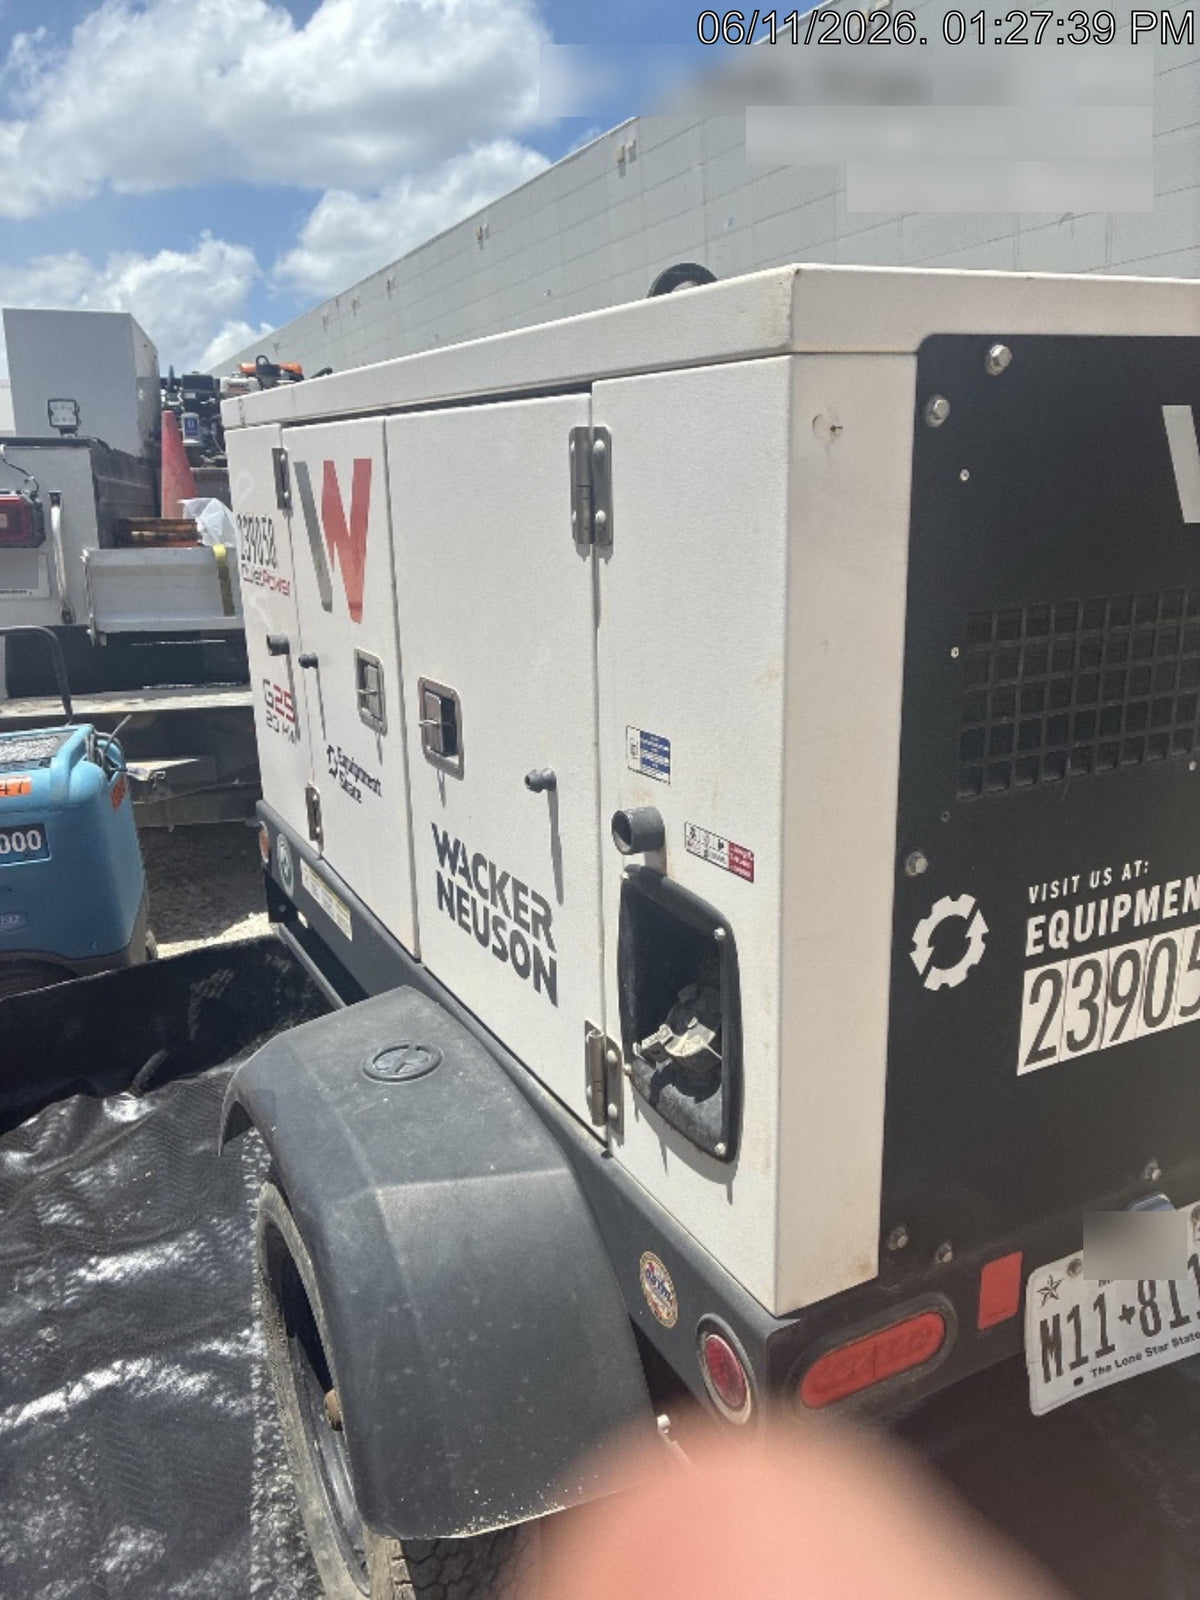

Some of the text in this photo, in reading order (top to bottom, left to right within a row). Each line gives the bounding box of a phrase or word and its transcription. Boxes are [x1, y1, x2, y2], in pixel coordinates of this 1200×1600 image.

[431, 822, 557, 954] WACKER
[1029, 859, 1150, 904] VISIT US AT:
[436, 870, 559, 1008] NEUSON
[1091, 1331, 1200, 1378] The Lone Star State
